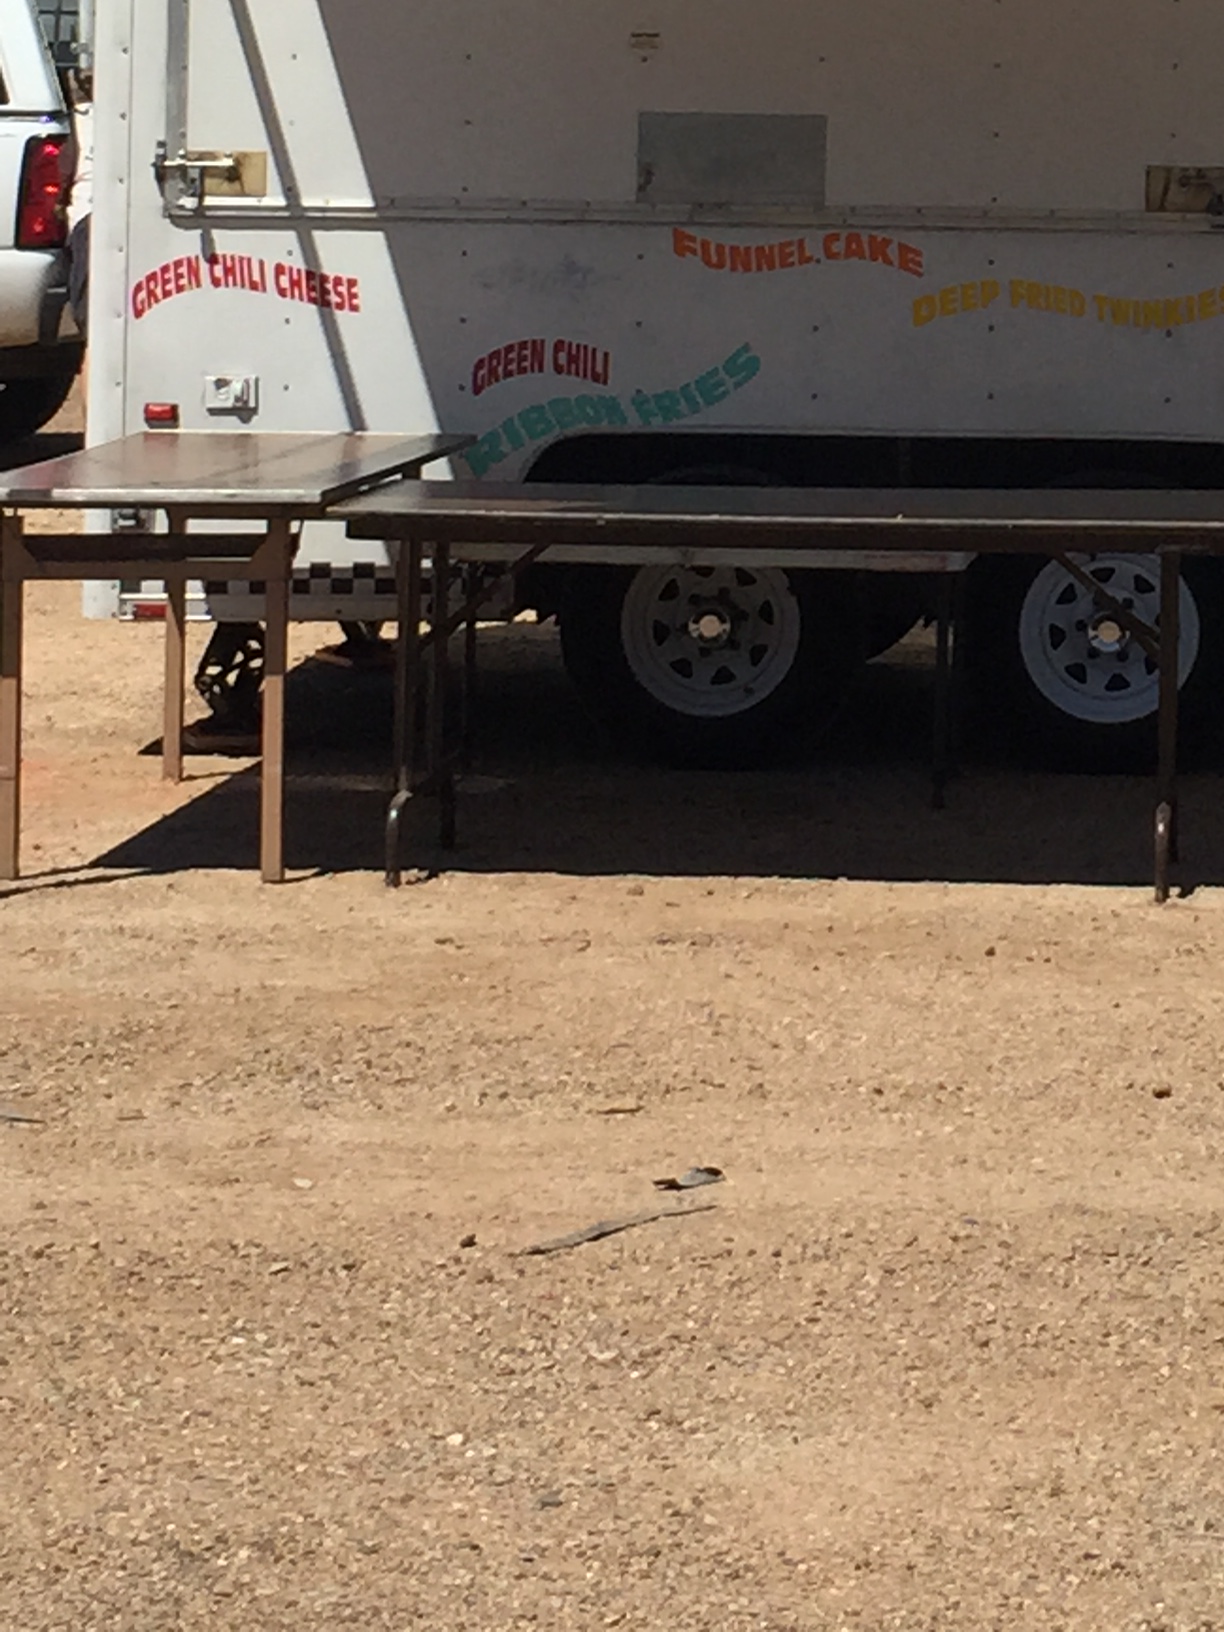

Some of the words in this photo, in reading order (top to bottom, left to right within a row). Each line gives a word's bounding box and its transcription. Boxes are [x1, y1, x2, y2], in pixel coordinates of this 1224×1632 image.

[672, 228, 813, 273] FUNNEL
[823, 232, 924, 278] CAKE
[131, 254, 202, 319] GREEN
[208, 253, 267, 293] CHILI
[274, 263, 360, 314] CHEESE
[912, 279, 999, 327] DEEP
[1009, 279, 1086, 317] FRIED
[472, 339, 545, 396] GREEN
[553, 339, 610, 386] CHILI
[464, 394, 628, 478] RIBBON
[631, 342, 761, 426] FRIES
